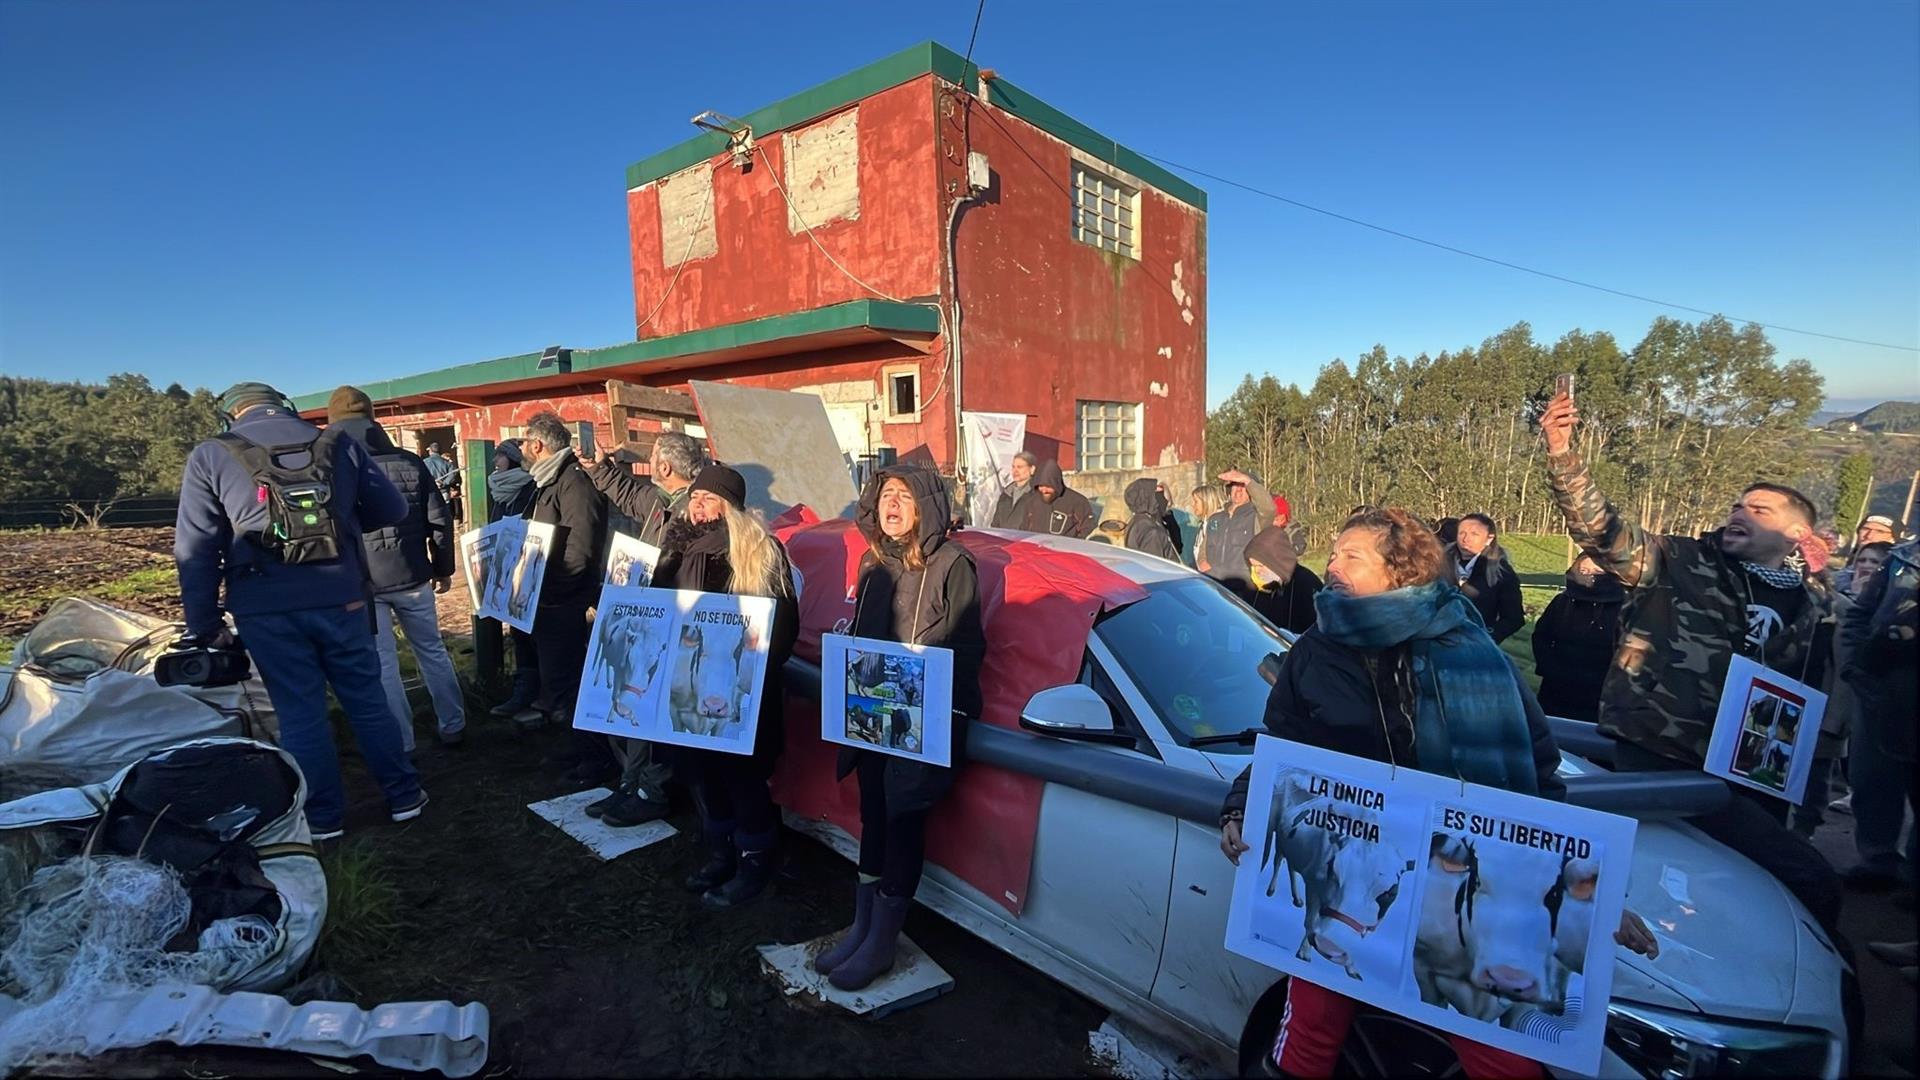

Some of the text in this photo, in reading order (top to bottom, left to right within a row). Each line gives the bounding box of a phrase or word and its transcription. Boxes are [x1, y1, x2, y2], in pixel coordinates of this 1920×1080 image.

[613, 604, 666, 619] ESTAS VACAS
[693, 610, 752, 628] NO SE TOCAN
[1309, 775, 1329, 798] LA
[1304, 808, 1380, 844] JUSTICIA
[1443, 808, 1591, 860] ES SU LIBERTAD
